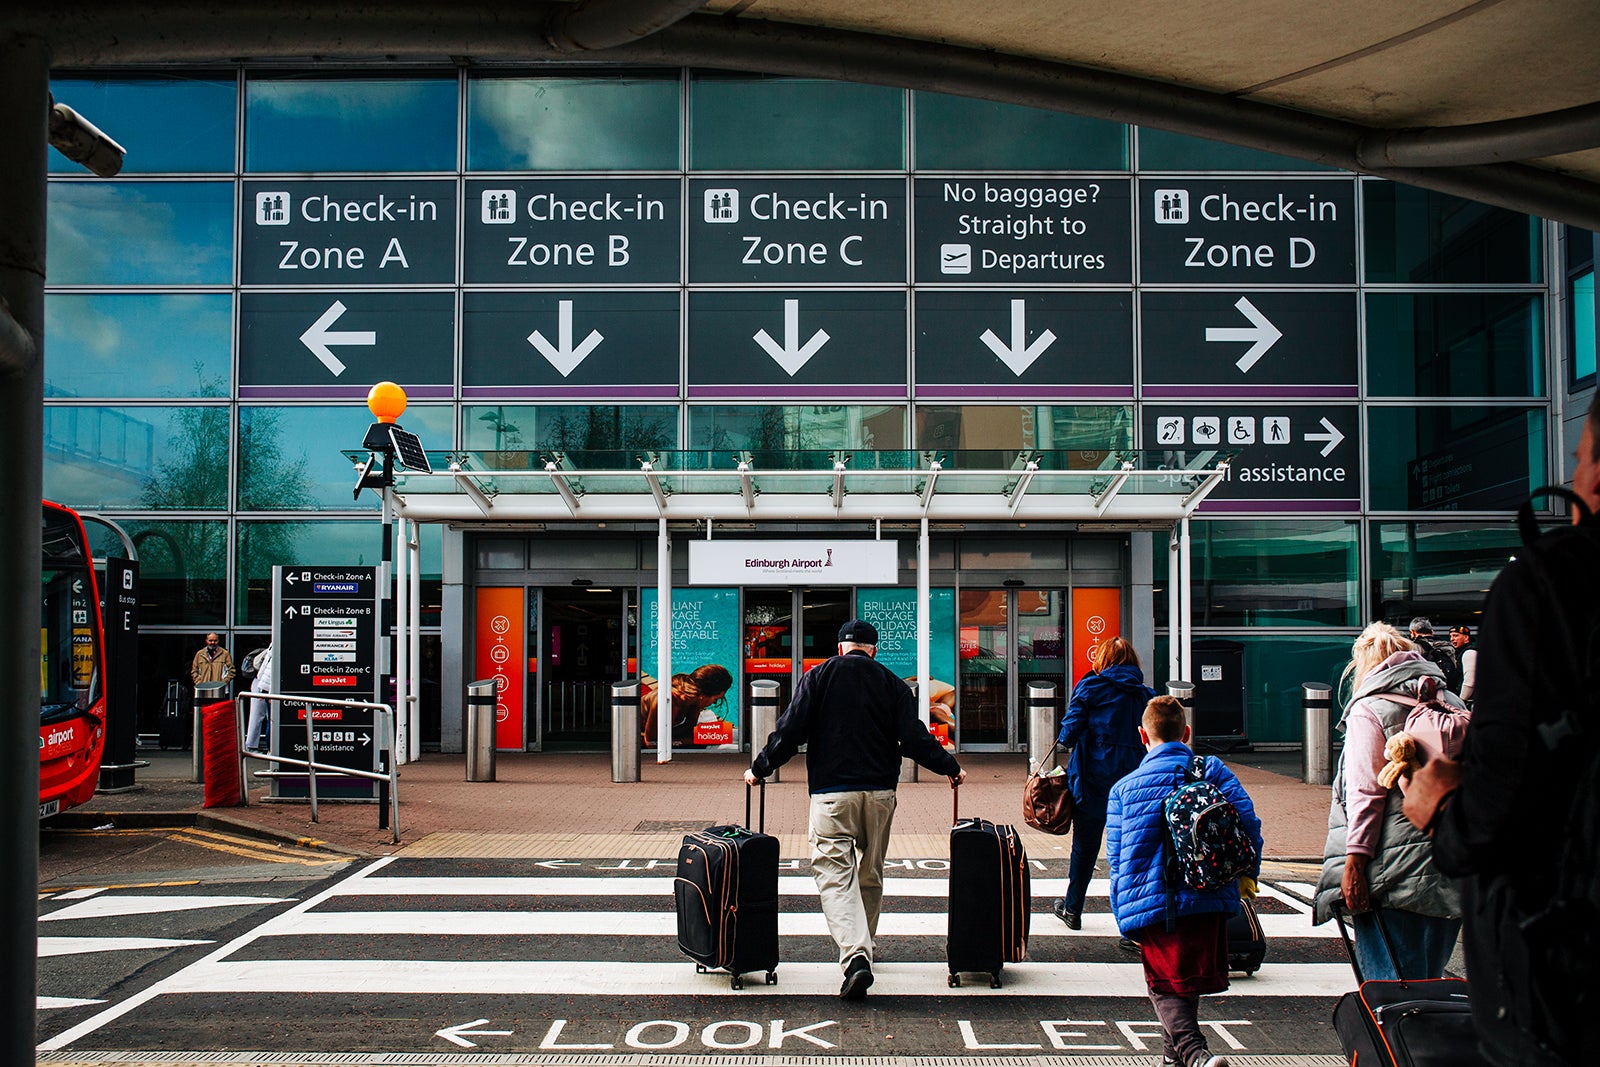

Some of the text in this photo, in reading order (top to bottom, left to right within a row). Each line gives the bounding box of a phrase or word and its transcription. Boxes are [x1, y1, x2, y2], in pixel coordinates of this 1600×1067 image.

[944, 184, 1100, 208] No baggage?
[301, 196, 437, 222] Check-in
[527, 194, 664, 220] Check-in
[750, 193, 888, 220] Check-in
[1200, 194, 1337, 222] Check-in
[959, 215, 1086, 240] Straight to
[278, 238, 409, 270] Zone A
[508, 235, 630, 266] Zone B
[742, 236, 863, 266] Zone C
[1184, 238, 1316, 268] Zone D
[982, 250, 1105, 275] Departures
[1240, 464, 1346, 482] assistance
[745, 558, 822, 569] Edinburgh Airport
[650, 602, 703, 610] BLIANT
[864, 601, 917, 610] BRILLIANT
[124, 611, 130, 630] E
[650, 611, 700, 620] PKAGE
[864, 611, 914, 620] PACKAGE
[650, 621, 716, 630] HIDAYS AT
[650, 630, 718, 639] UBEATABLE
[870, 621, 916, 630] OLIDAYS
[876, 641, 903, 650] ICES.
[48, 727, 74, 746] airport
[697, 731, 729, 741] holidays
[539, 1020, 1252, 1050] LOOK LEFT
